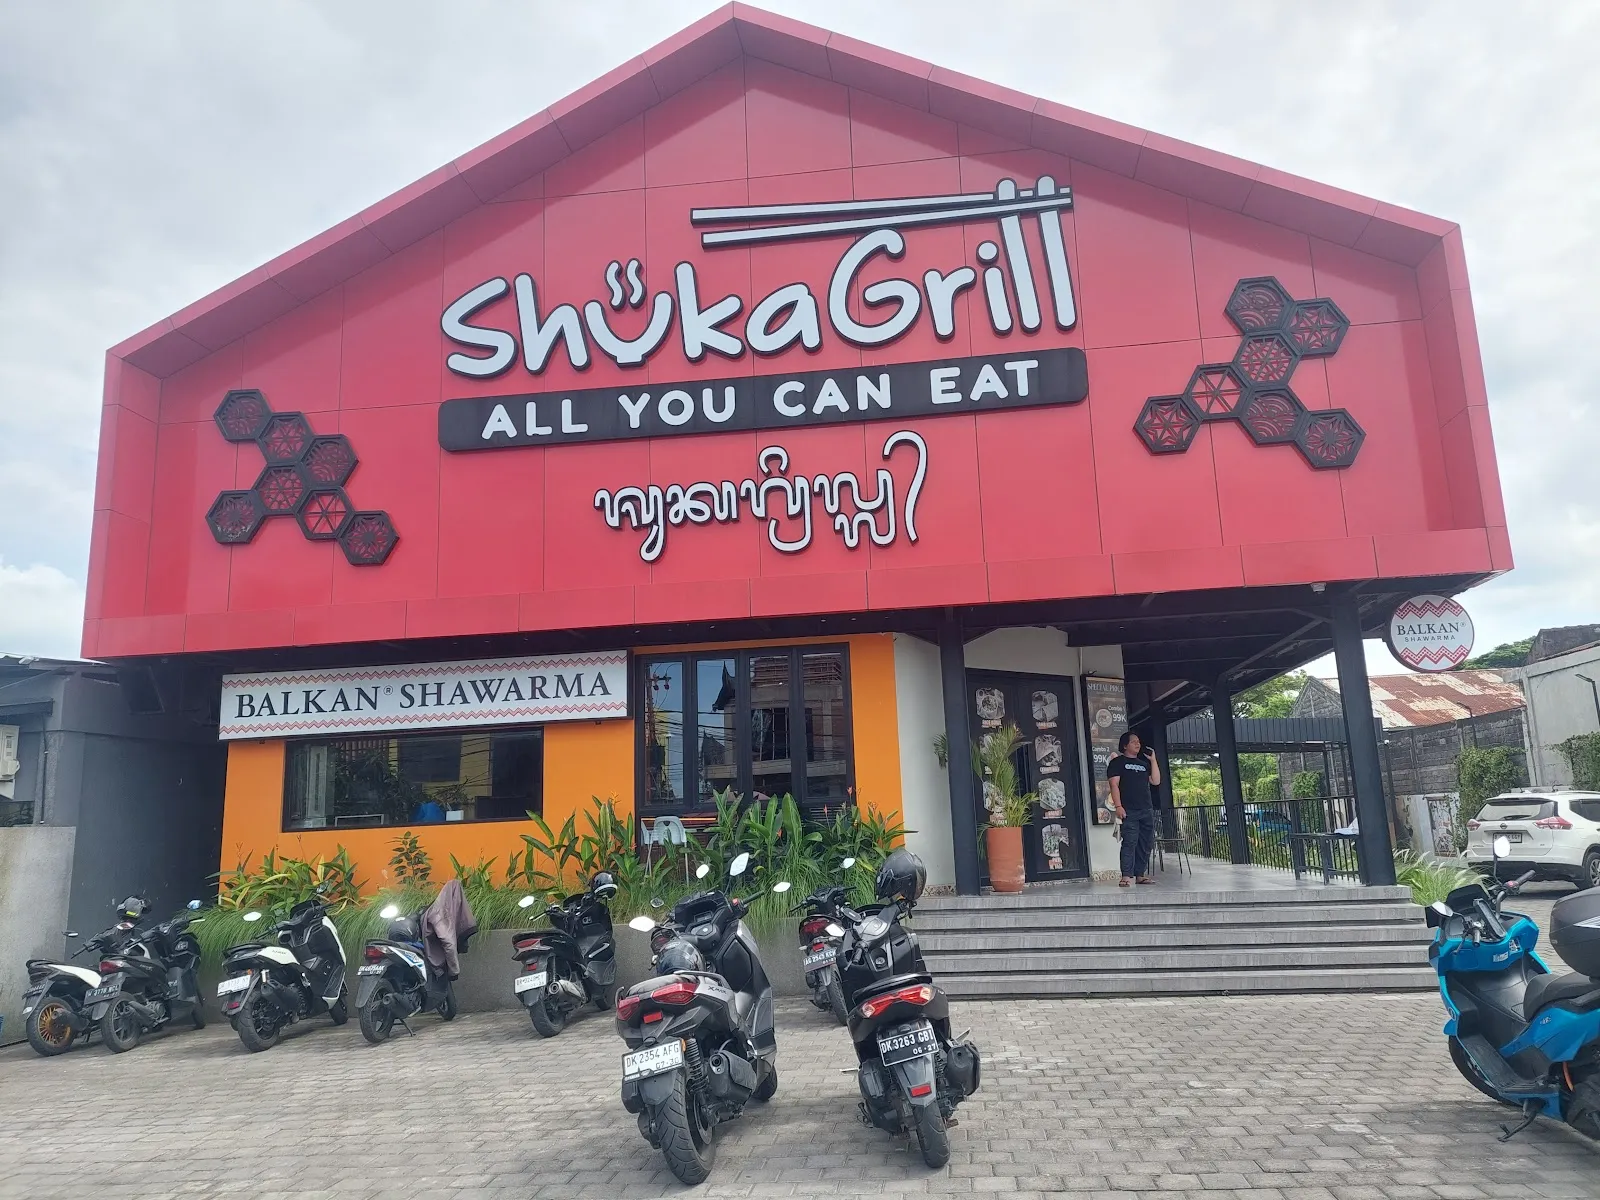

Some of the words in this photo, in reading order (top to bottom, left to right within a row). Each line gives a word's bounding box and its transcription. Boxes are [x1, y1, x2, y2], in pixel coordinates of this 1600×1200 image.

[481, 398, 589, 440] ALL
[617, 386, 736, 429] YOU
[773, 373, 892, 417] CAN
[929, 359, 1039, 405] EAT
[1404, 635, 1456, 643] SHAWARMA
[399, 671, 613, 709] SHAWARMA
[1112, 713, 1127, 722] 99K
[1093, 754, 1107, 763] 99K
[880, 1040, 893, 1053] DK
[892, 1034, 915, 1050] 3263
[626, 1055, 637, 1068] DK
[639, 1048, 661, 1064] 2354
[662, 1043, 679, 1057] AFG
